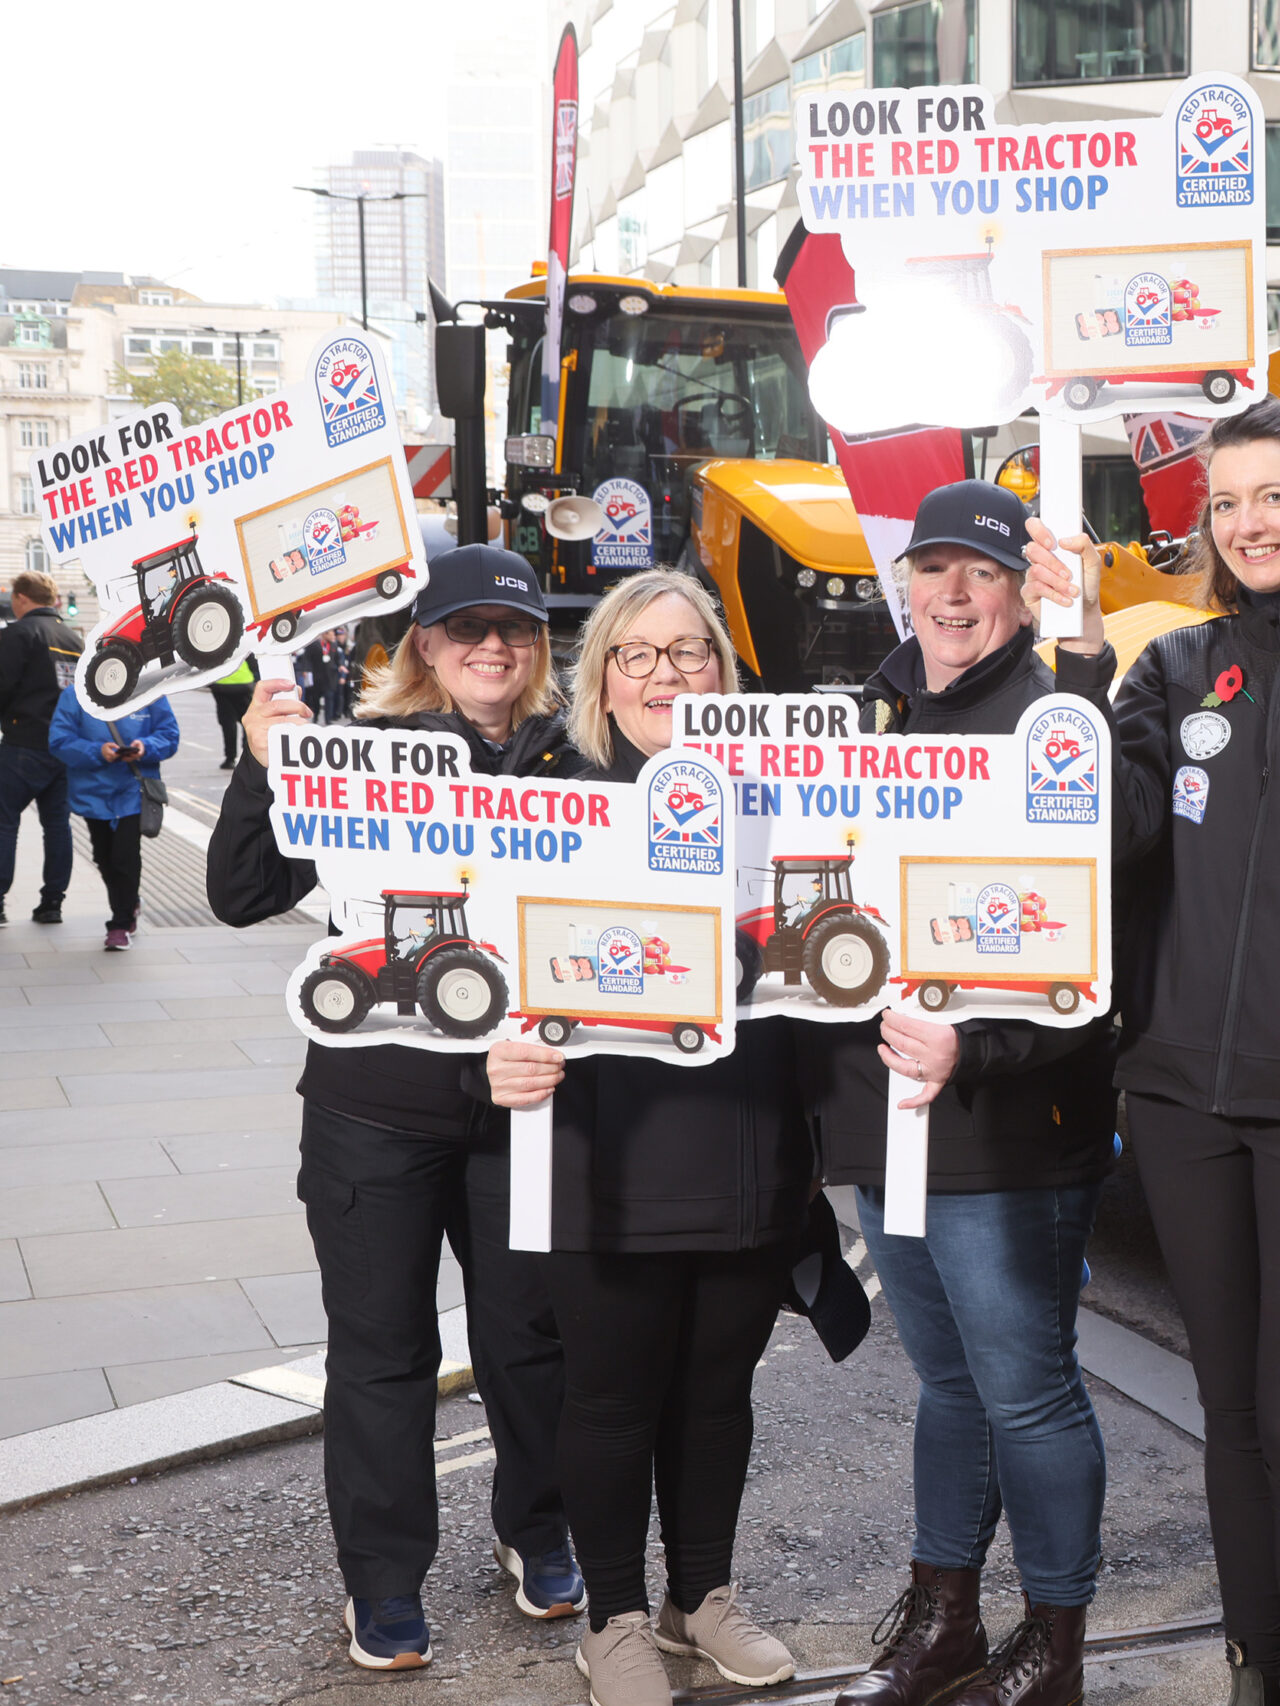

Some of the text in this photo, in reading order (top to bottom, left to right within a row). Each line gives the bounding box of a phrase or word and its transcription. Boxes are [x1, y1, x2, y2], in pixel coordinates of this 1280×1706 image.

[810, 96, 985, 137] LOOK FOR
[1182, 90, 1247, 122] RED TRACTOR
[809, 131, 1138, 178] THE RED TRACTOR
[809, 175, 1108, 219] WHEN YOU SHOP
[1179, 190, 1251, 205] STANDARDS
[1183, 177, 1246, 191] CERTIFIED
[1129, 328, 1168, 337] CERTIFIED
[319, 343, 367, 377] RED TRACTOR
[329, 415, 384, 445] STANDARDS
[330, 407, 379, 433] CERTIFIED
[38, 413, 173, 488] LOOK FOR
[43, 401, 294, 520] THE RED TRACTOR
[49, 443, 275, 552] WHEN YOU SHOP
[610, 480, 647, 505] TRACTOR
[974, 514, 1010, 536] JCB
[594, 556, 651, 566] STANDARDS
[596, 547, 648, 556] CERTIFIED
[494, 576, 528, 592] JCB
[684, 704, 849, 738] LOOK FOR
[1032, 712, 1093, 742] RED TRACTOR
[281, 735, 460, 777] LOOK FOR
[760, 744, 824, 777] RED
[838, 746, 990, 780] TRACTOR
[654, 766, 717, 796] RED TRACTOR
[281, 773, 610, 827] THE RED TRACTOR
[733, 783, 962, 819] EN YOU SHOP
[1028, 808, 1096, 821] STANDARDS
[1032, 796, 1092, 808] CERTIFIED
[282, 813, 582, 863] WHEN YOU SHOP
[655, 845, 716, 860] CERTIFIED
[651, 857, 720, 872] STANDARDS
[602, 977, 639, 985] CERTIFIED
